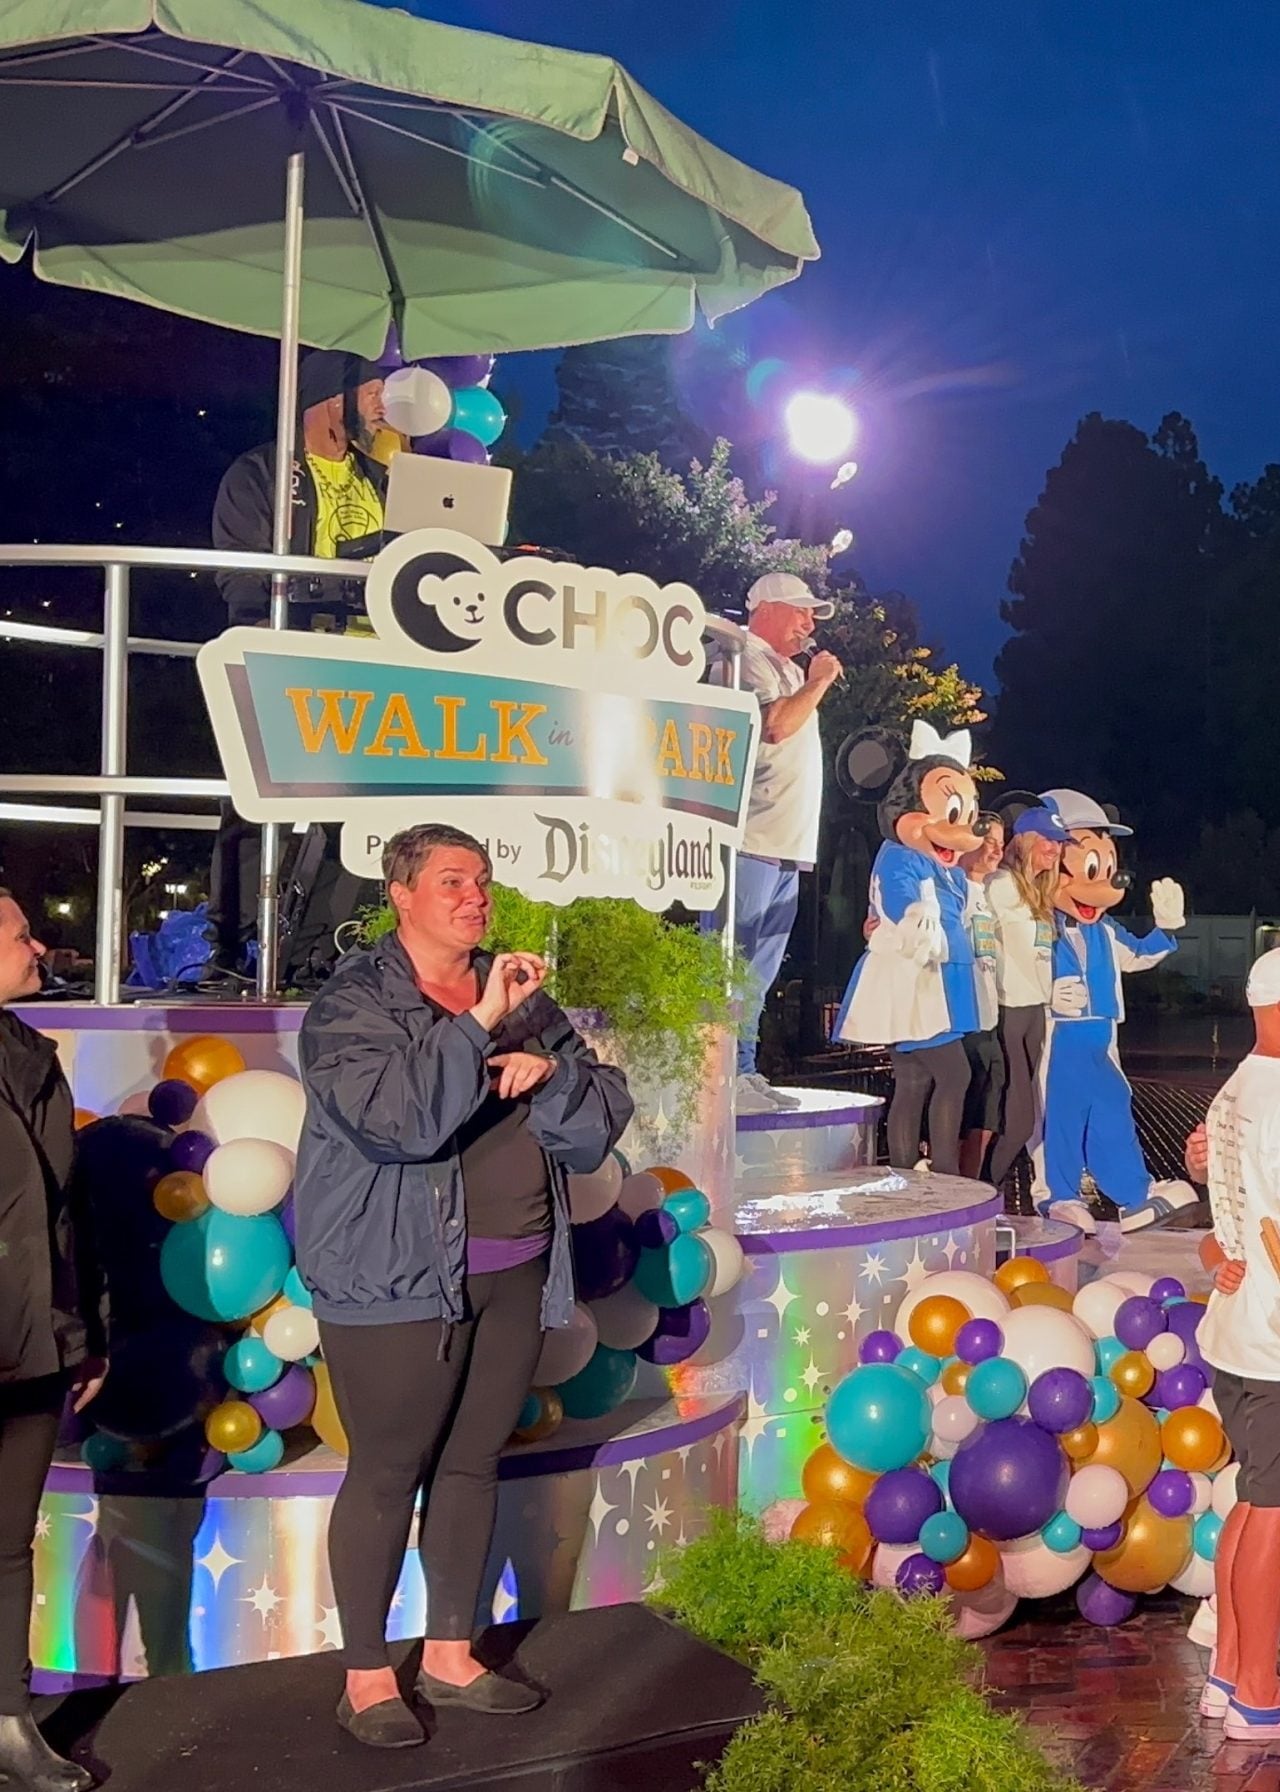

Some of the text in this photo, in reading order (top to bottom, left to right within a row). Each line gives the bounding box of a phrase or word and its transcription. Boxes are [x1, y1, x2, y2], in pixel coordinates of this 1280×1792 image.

[503, 579, 694, 666] CHOC
[285, 687, 548, 766] WALK
[547, 720, 574, 746] in
[497, 838, 522, 864] by
[533, 811, 714, 891] Disyland
